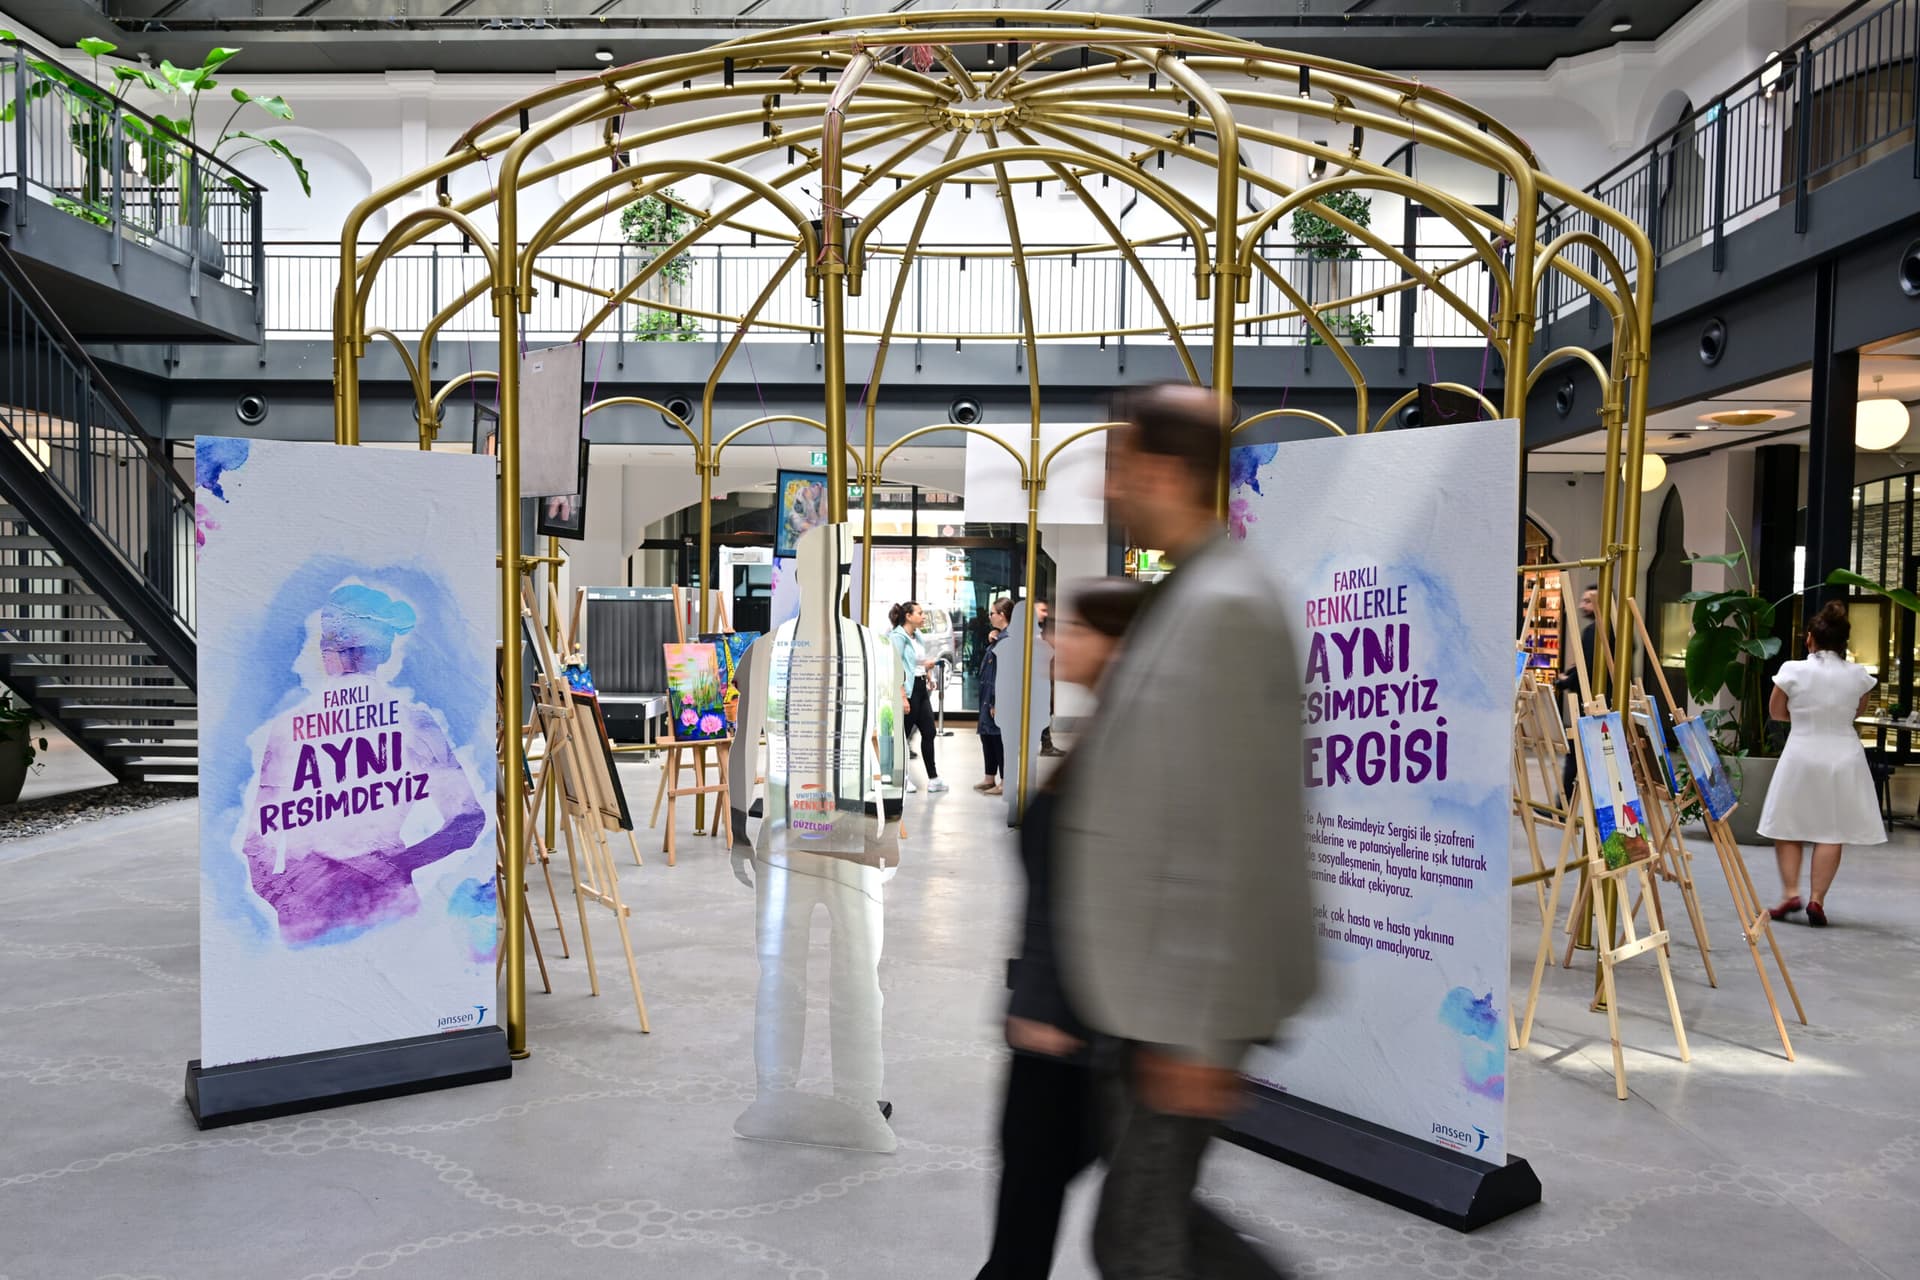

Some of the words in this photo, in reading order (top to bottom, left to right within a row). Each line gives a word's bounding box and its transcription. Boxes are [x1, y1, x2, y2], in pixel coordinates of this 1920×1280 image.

[1334, 566, 1377, 592] FARKLI
[1306, 585, 1408, 628] RENKLERLE
[1305, 623, 1410, 684] AYNI
[323, 685, 369, 709] FARKLI
[1300, 674, 1438, 724] ESİMDEYİZ
[292, 700, 399, 741] RENKLERLE
[292, 731, 402, 792] AYNI
[1303, 716, 1448, 788] ERGİSİ
[260, 771, 430, 835] RESİMDEYİZ
[1317, 812, 1335, 829] Aynı
[1337, 814, 1385, 837] Resimdeyiz
[1388, 822, 1417, 842] Sergisi
[1420, 826, 1431, 842] ile
[1434, 830, 1475, 849] şizofreni
[1318, 852, 1383, 875] sosyalleşmenin,
[1386, 859, 1417, 879] hayata
[1420, 865, 1473, 889] karışmanın
[1347, 839, 1357, 850] ve
[1360, 840, 1429, 861] potansiyellerine
[1432, 848, 1448, 866] ışık
[1452, 854, 1487, 871] tutarak
[1339, 871, 1365, 888] dikkat
[1368, 877, 1413, 898] çekiyoruz.
[1318, 922, 1342, 940] ilham
[1344, 928, 1373, 950] olmayı
[1376, 939, 1433, 961] amaçlıyoruz.
[1331, 907, 1345, 923] çok
[1348, 909, 1370, 928] hasta
[1373, 920, 1384, 930] ve
[1386, 916, 1411, 936] hasta
[1414, 924, 1454, 946] yakınına
